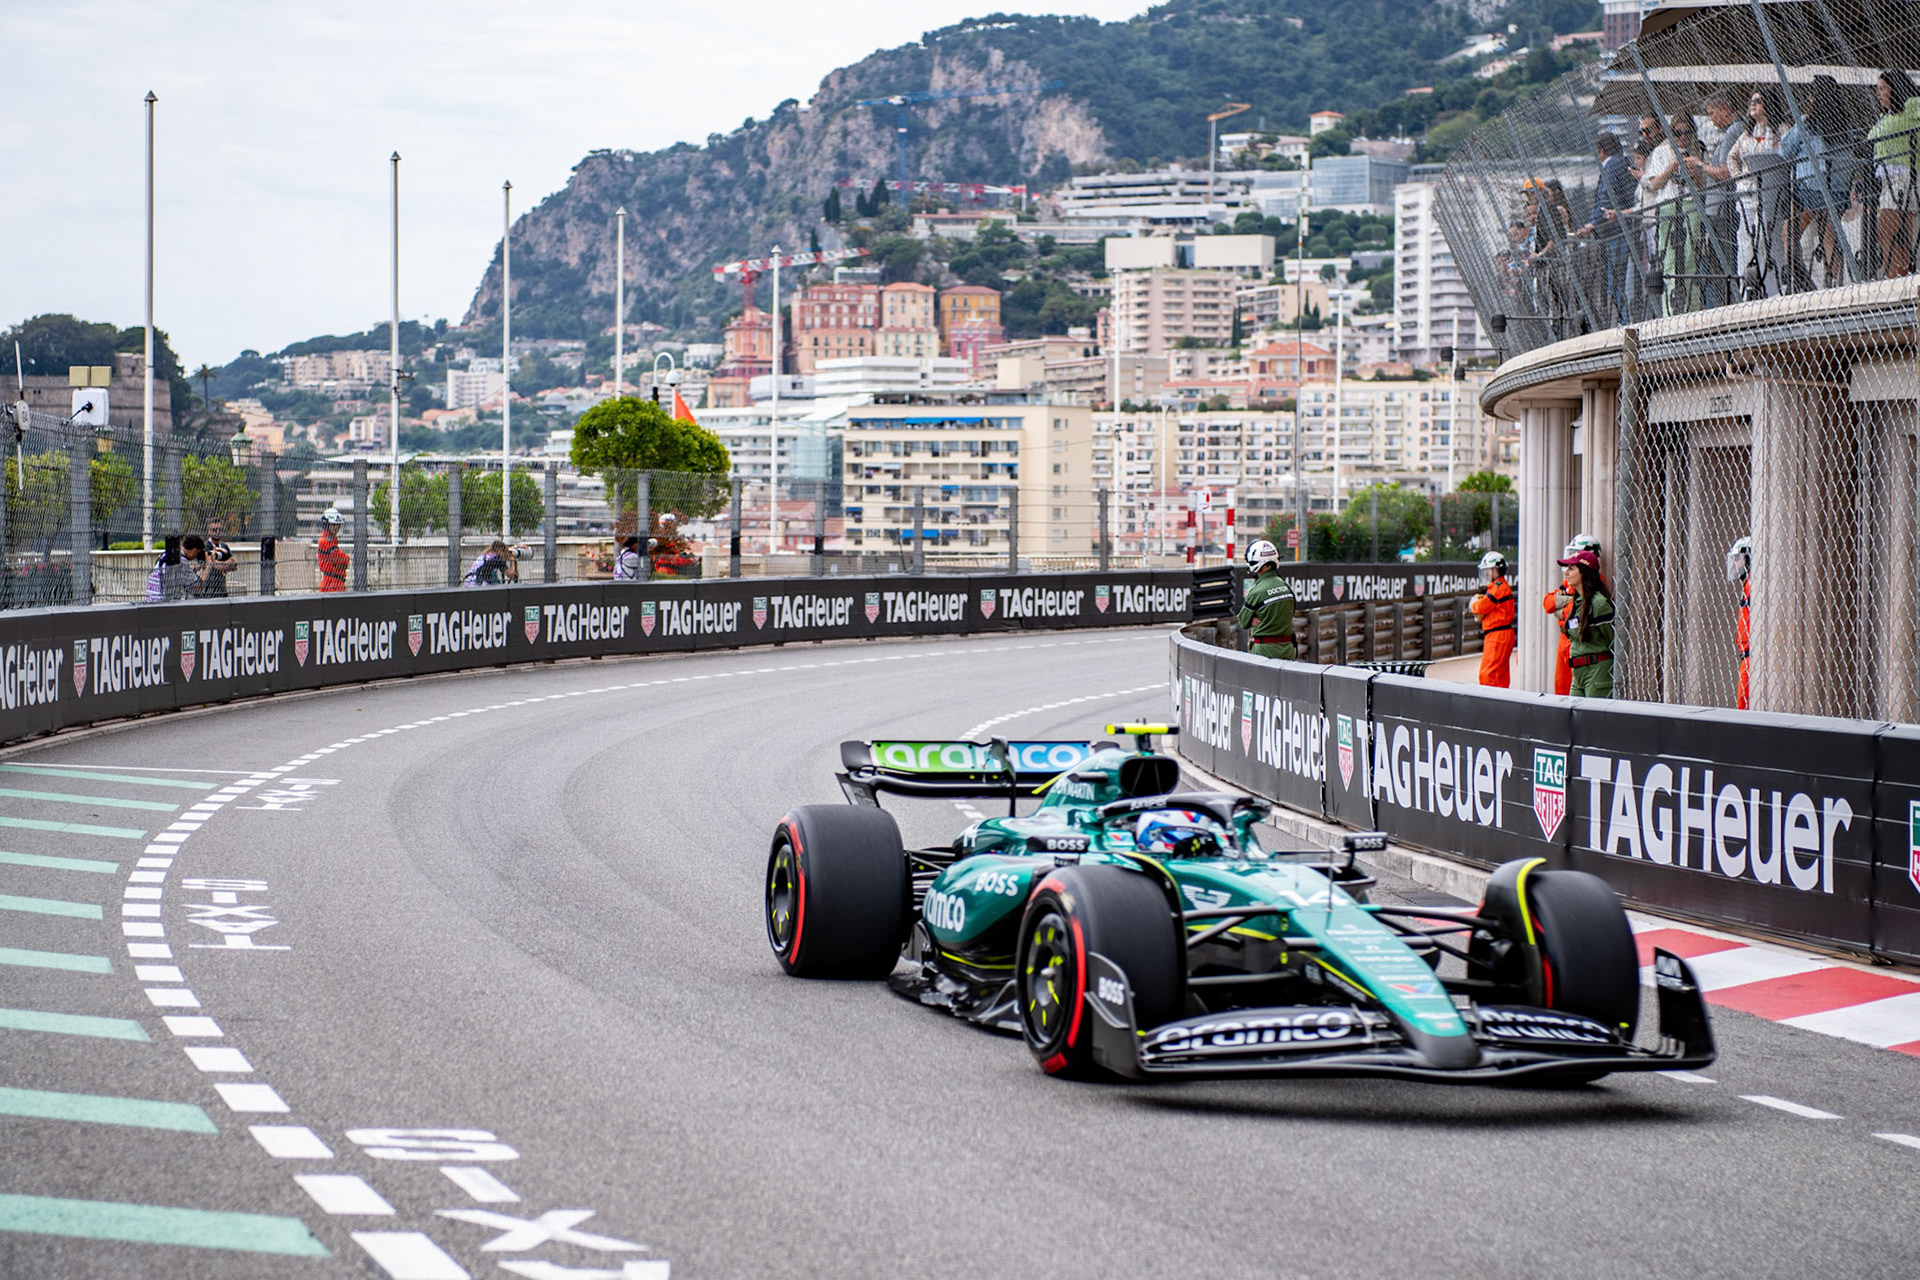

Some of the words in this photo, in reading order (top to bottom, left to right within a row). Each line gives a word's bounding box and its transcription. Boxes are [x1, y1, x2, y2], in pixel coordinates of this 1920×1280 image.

[1000, 588, 1084, 617] TAGHeuer
[1113, 585, 1191, 612] TAGHeuer
[1284, 577, 1325, 602] Heuer
[526, 609, 539, 621] TAG
[660, 600, 741, 635] TAGHeuer
[771, 595, 853, 628] TAGHeuer
[883, 592, 968, 622] TAGHeuer
[296, 625, 308, 640] TAG
[409, 618, 422, 632] TAG
[427, 610, 512, 654] TAGHeuer
[544, 604, 629, 642] TAGHeuer
[75, 643, 86, 662] TAG
[183, 634, 194, 651] TAG
[200, 628, 283, 680] TAGHeuer
[313, 618, 396, 665] TAGHeuer
[91, 635, 169, 694] TAGHeuer
[1339, 719, 1352, 744] TAG
[884, 744, 1082, 769] aramco
[1536, 755, 1564, 786] TAG
[1535, 789, 1564, 832] HEUER
[1581, 754, 1853, 894] TAGHeuer
[1047, 839, 1086, 851] BOSS
[1354, 838, 1384, 849] BOSS
[975, 872, 1019, 896] BOSS
[923, 887, 965, 932] ramco
[1099, 977, 1124, 1005] BOSS
[1156, 1012, 1351, 1050] aramco
